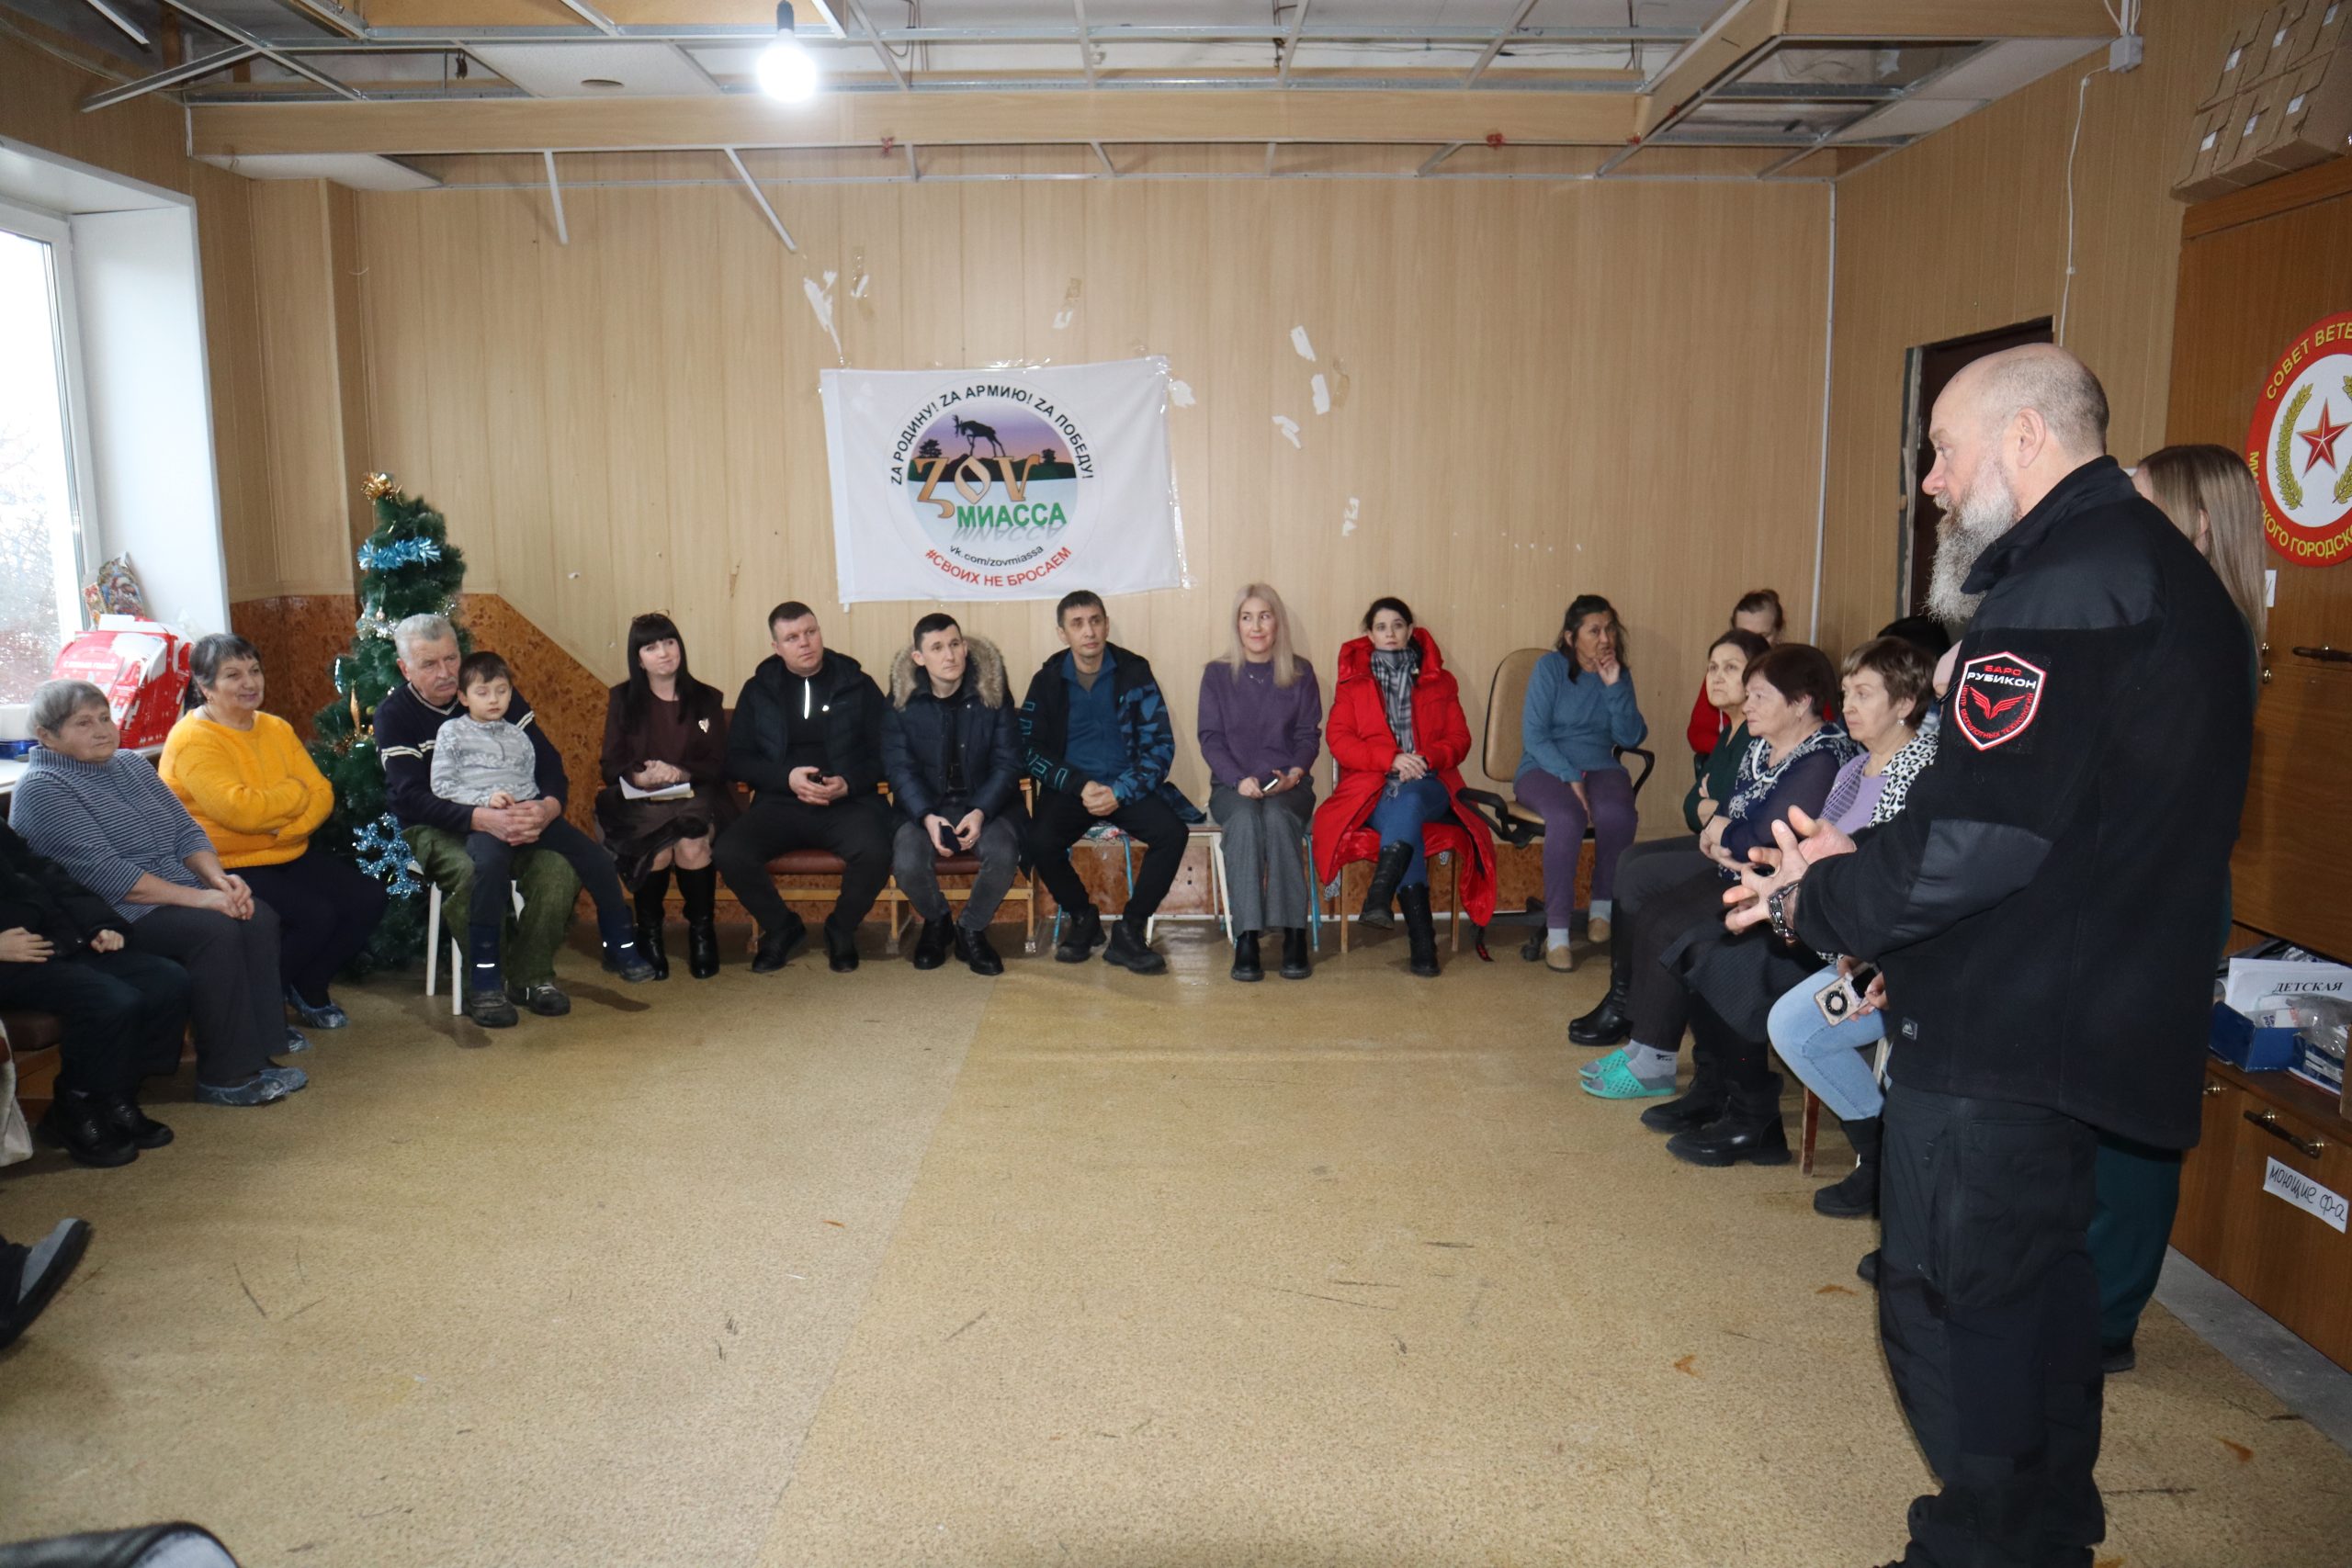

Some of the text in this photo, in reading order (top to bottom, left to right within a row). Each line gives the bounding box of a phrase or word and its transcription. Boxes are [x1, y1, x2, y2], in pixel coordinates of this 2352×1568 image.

[2267, 338, 2310, 400] СОВЕТ
[892, 401, 939, 462] РОДИНУ!
[966, 385, 1034, 404] АРМИЮ!
[1056, 414, 1094, 479] ПОБЕДУ!
[913, 454, 1041, 519] ZOV
[956, 502, 1068, 528] МИАССА
[925, 546, 1072, 586] #СВОИХ НЕ БРОСАЕМ
[950, 545, 1044, 566] vk.com/zovmiassa
[1967, 671, 2037, 690] РУБИКОН
[1984, 665, 2022, 676] БАРС
[2272, 982, 2344, 993] ДЕТСКАЯ
